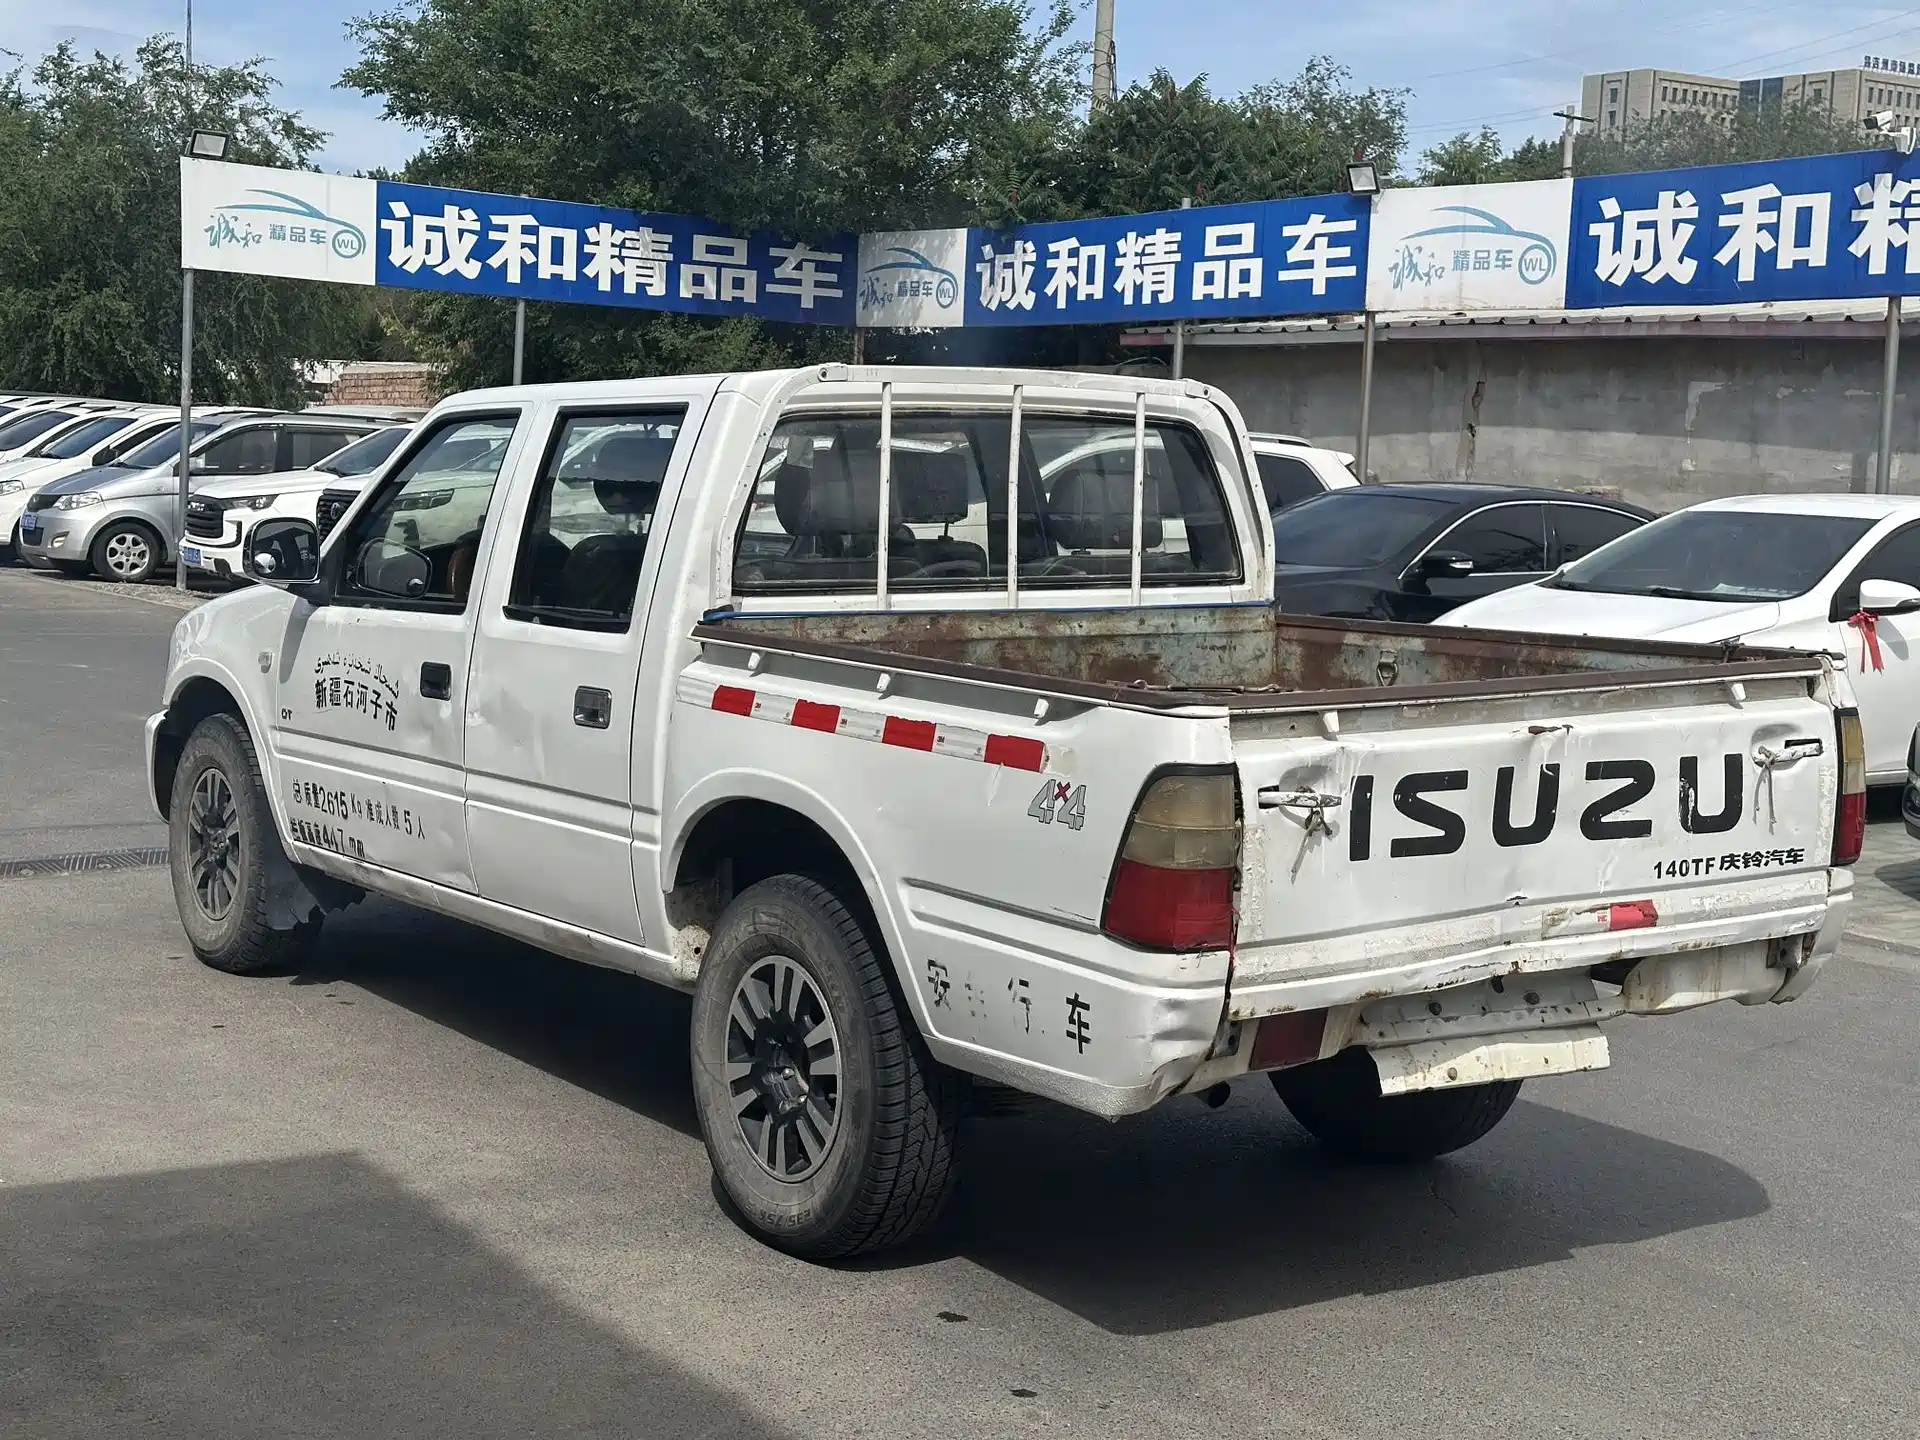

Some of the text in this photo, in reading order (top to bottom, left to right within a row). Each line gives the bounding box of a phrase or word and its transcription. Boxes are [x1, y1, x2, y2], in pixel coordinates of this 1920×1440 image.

[269, 223, 327, 245] 精品车
[336, 238, 358, 250] WL
[381, 202, 844, 309] 诚和精品车
[975, 213, 1357, 312] 诚和精品车
[1452, 248, 1514, 272] 精品车
[1523, 257, 1547, 273] WL
[897, 280, 933, 298] 精品车
[938, 289, 953, 299] WL
[315, 676, 398, 731] 新疆石河子市
[1350, 753, 1744, 862] ISUZU
[404, 809, 413, 835] 5
[417, 816, 426, 840] 人
[1653, 848, 1805, 879] 140TF 庆铃汽车
